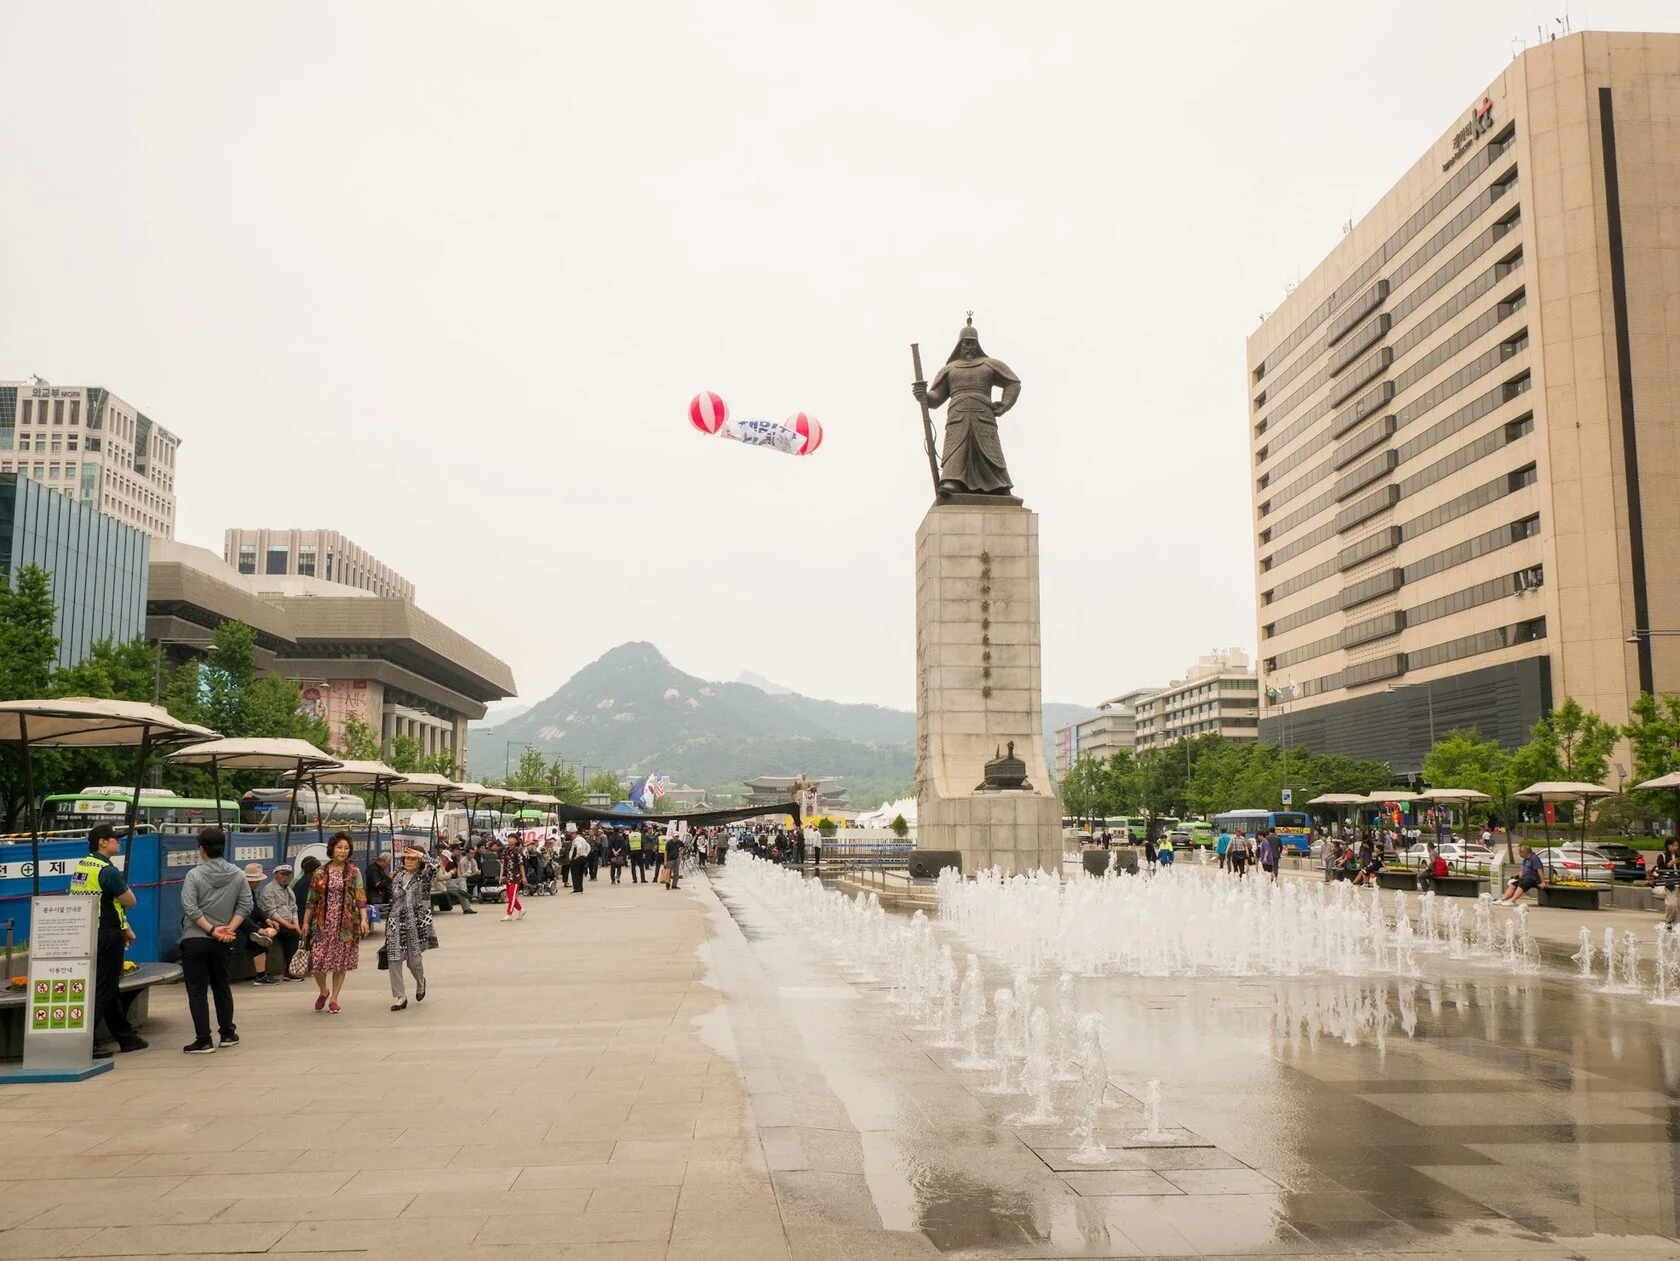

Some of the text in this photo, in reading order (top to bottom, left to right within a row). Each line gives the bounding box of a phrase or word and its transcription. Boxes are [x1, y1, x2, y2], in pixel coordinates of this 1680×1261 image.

[1472, 96, 1494, 140] kt
[32, 388, 60, 398] 외교부
[49, 861, 65, 874] 제
